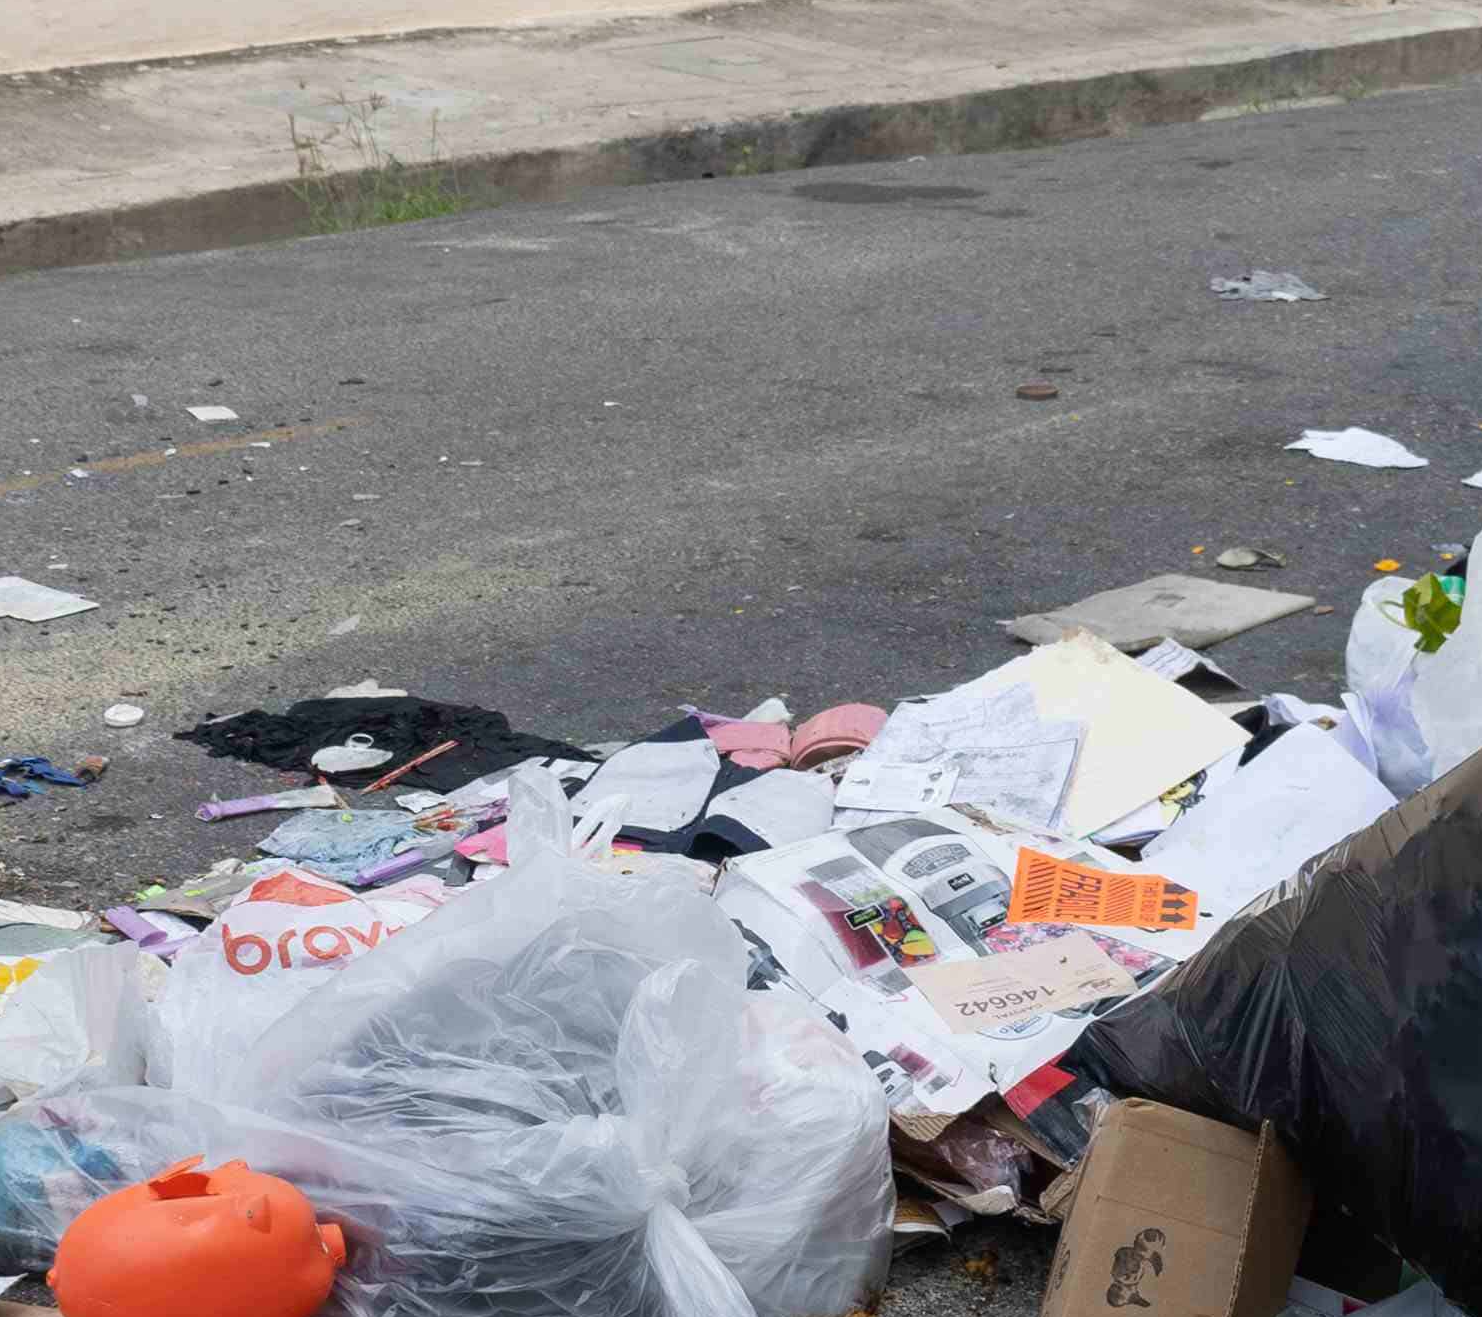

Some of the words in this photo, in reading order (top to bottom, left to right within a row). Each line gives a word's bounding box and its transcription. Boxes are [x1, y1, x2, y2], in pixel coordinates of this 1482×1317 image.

[1058, 867, 1102, 921] FRAGILE
[221, 918, 406, 976] brav
[954, 984, 1056, 1017] 146642
